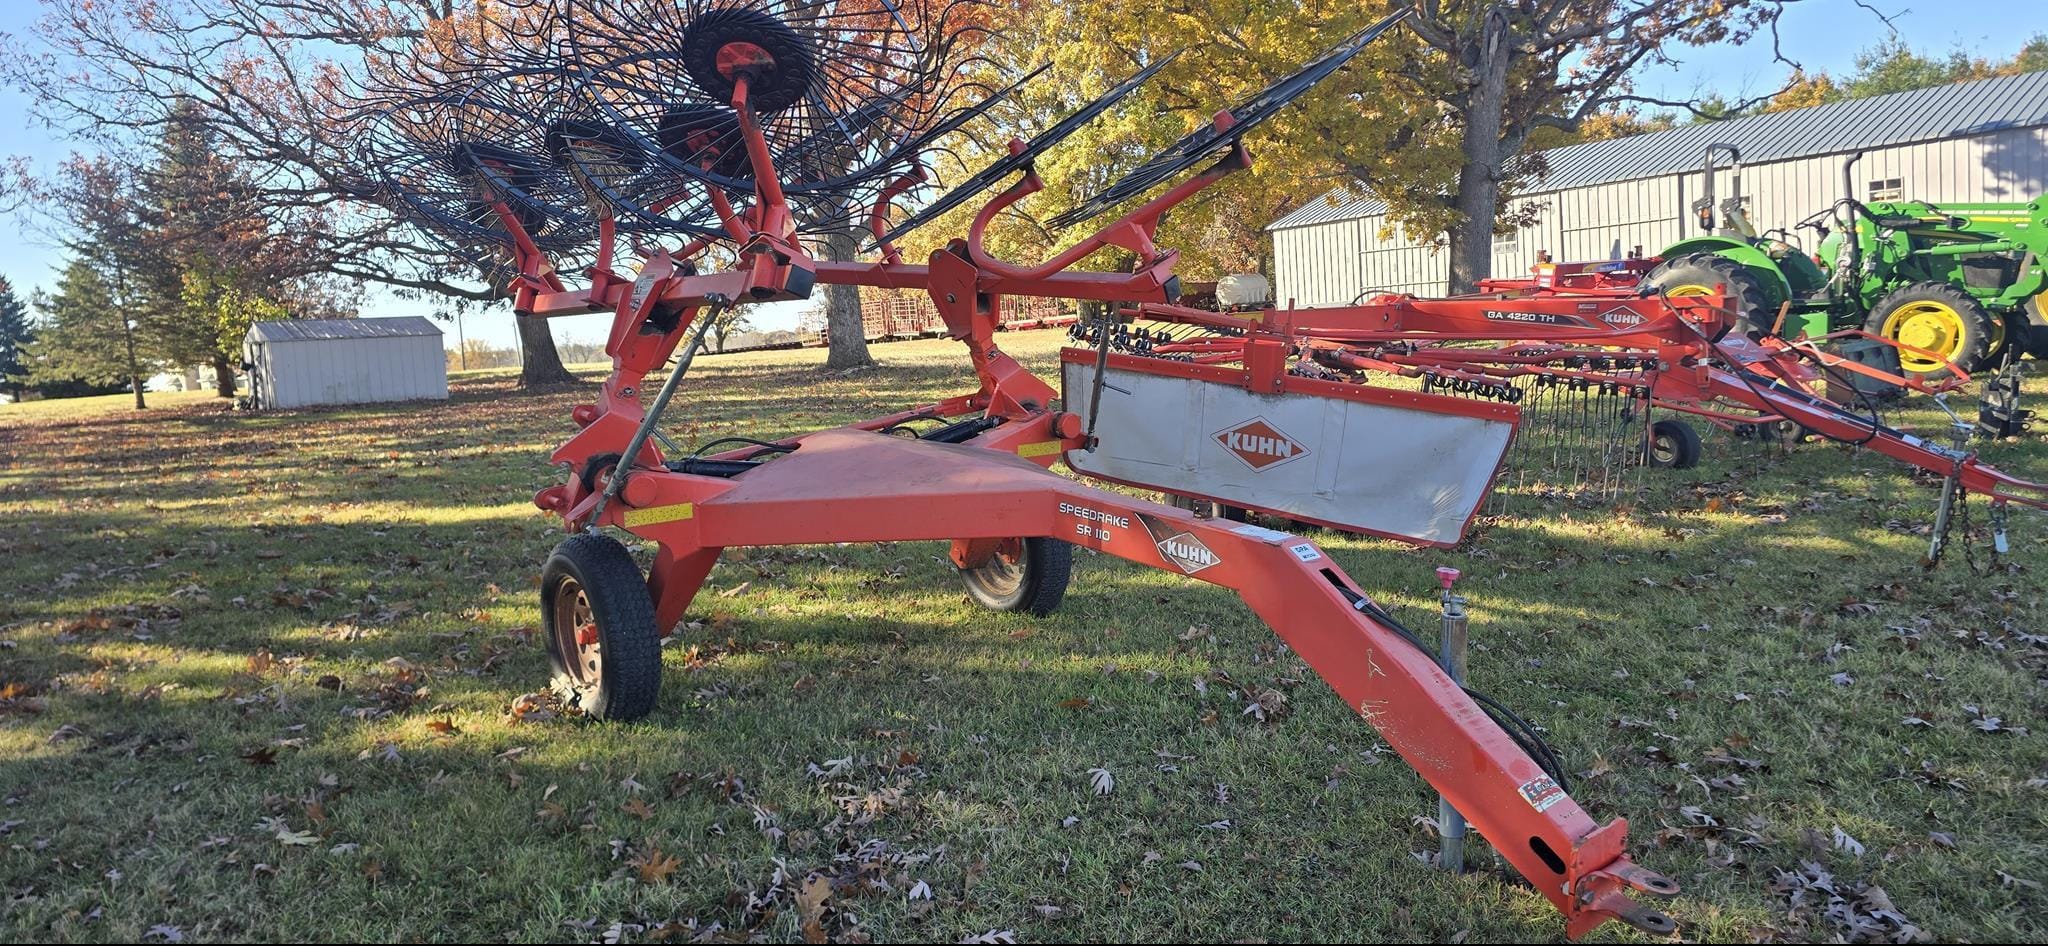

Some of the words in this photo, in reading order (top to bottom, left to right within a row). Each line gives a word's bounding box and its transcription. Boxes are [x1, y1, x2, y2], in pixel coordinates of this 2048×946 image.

[1487, 311, 1503, 319] GA
[1507, 312, 1535, 321] 4220
[1539, 314, 1556, 323] TH
[1605, 313, 1640, 324] KUHN
[1227, 431, 1292, 458] KUHN
[1059, 502, 1129, 529] SPEEDRAKE
[1076, 524, 1093, 538] SR
[1095, 527, 1111, 542] 110
[1166, 540, 1212, 565] KUHN
